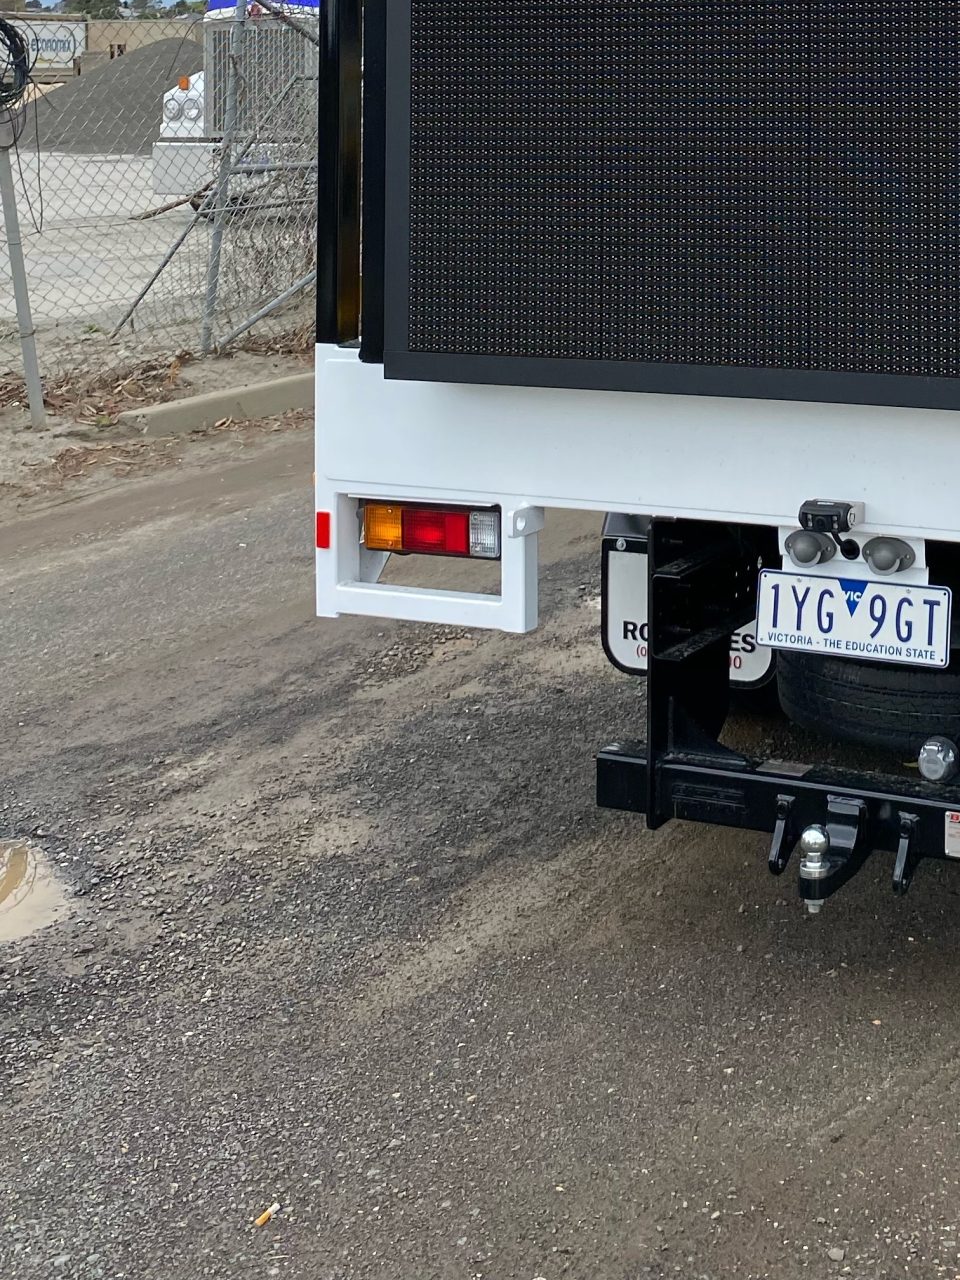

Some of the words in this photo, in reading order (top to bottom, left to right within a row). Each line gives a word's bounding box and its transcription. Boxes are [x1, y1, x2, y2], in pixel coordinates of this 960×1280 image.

[843, 590, 863, 602] VIC
[771, 583, 835, 634] 1YG
[869, 594, 941, 646] 9GT
[768, 632, 813, 646] VICTORIA
[823, 638, 842, 649] THE
[845, 640, 902, 656] EDUCATION
[905, 647, 936, 660] STATE
